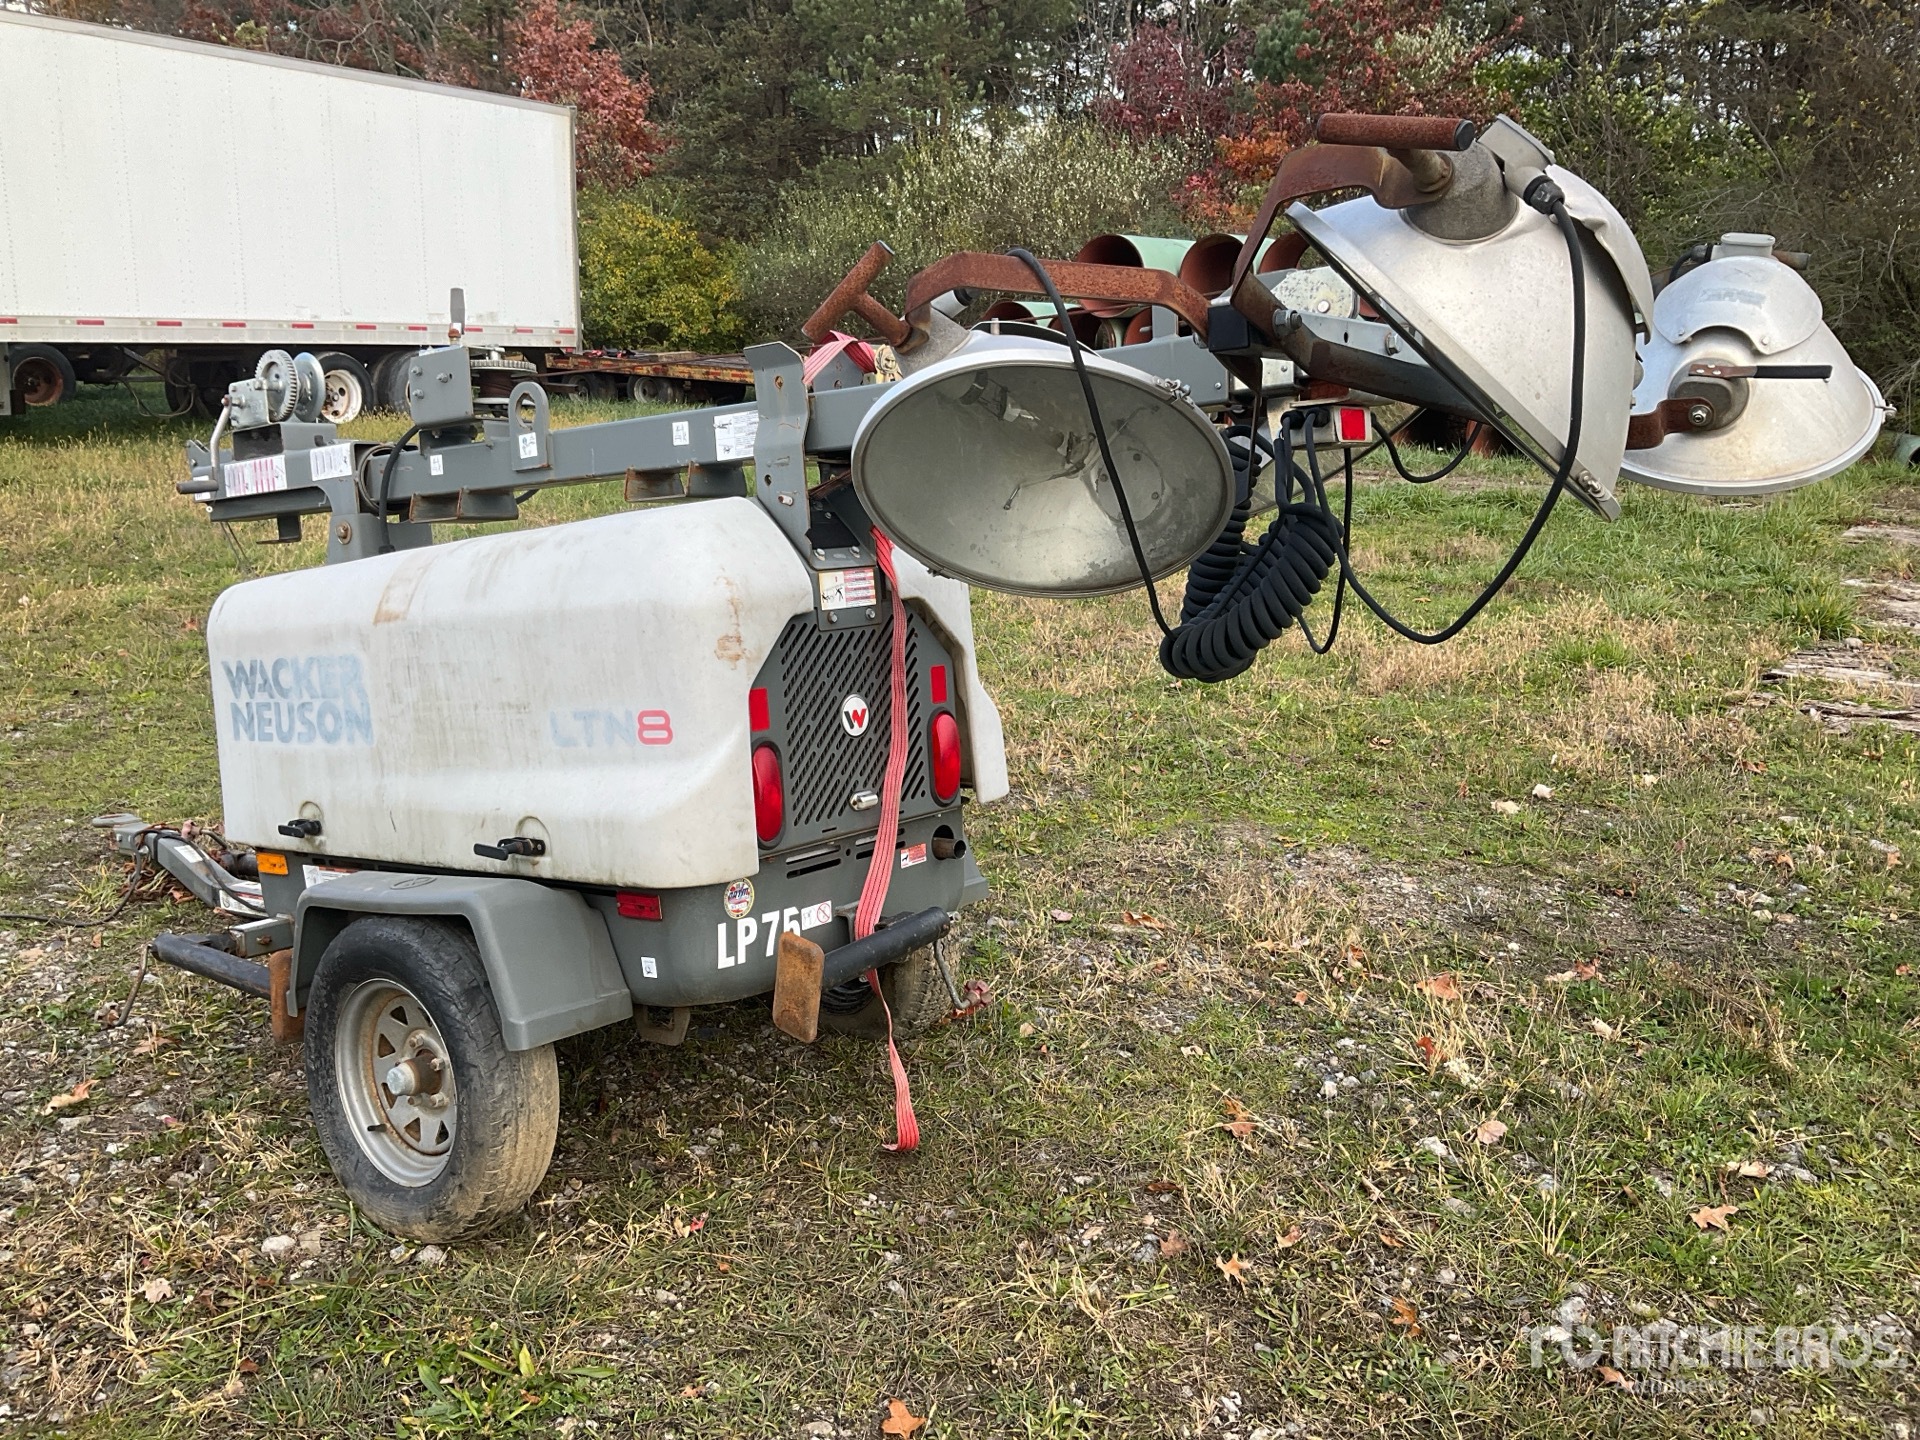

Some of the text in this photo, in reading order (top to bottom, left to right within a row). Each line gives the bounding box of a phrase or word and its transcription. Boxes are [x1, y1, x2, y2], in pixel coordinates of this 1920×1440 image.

[221, 654, 368, 699] WACKER
[231, 701, 374, 745] NEUSON
[549, 709, 674, 747] LTN8
[717, 917, 758, 970] LP
